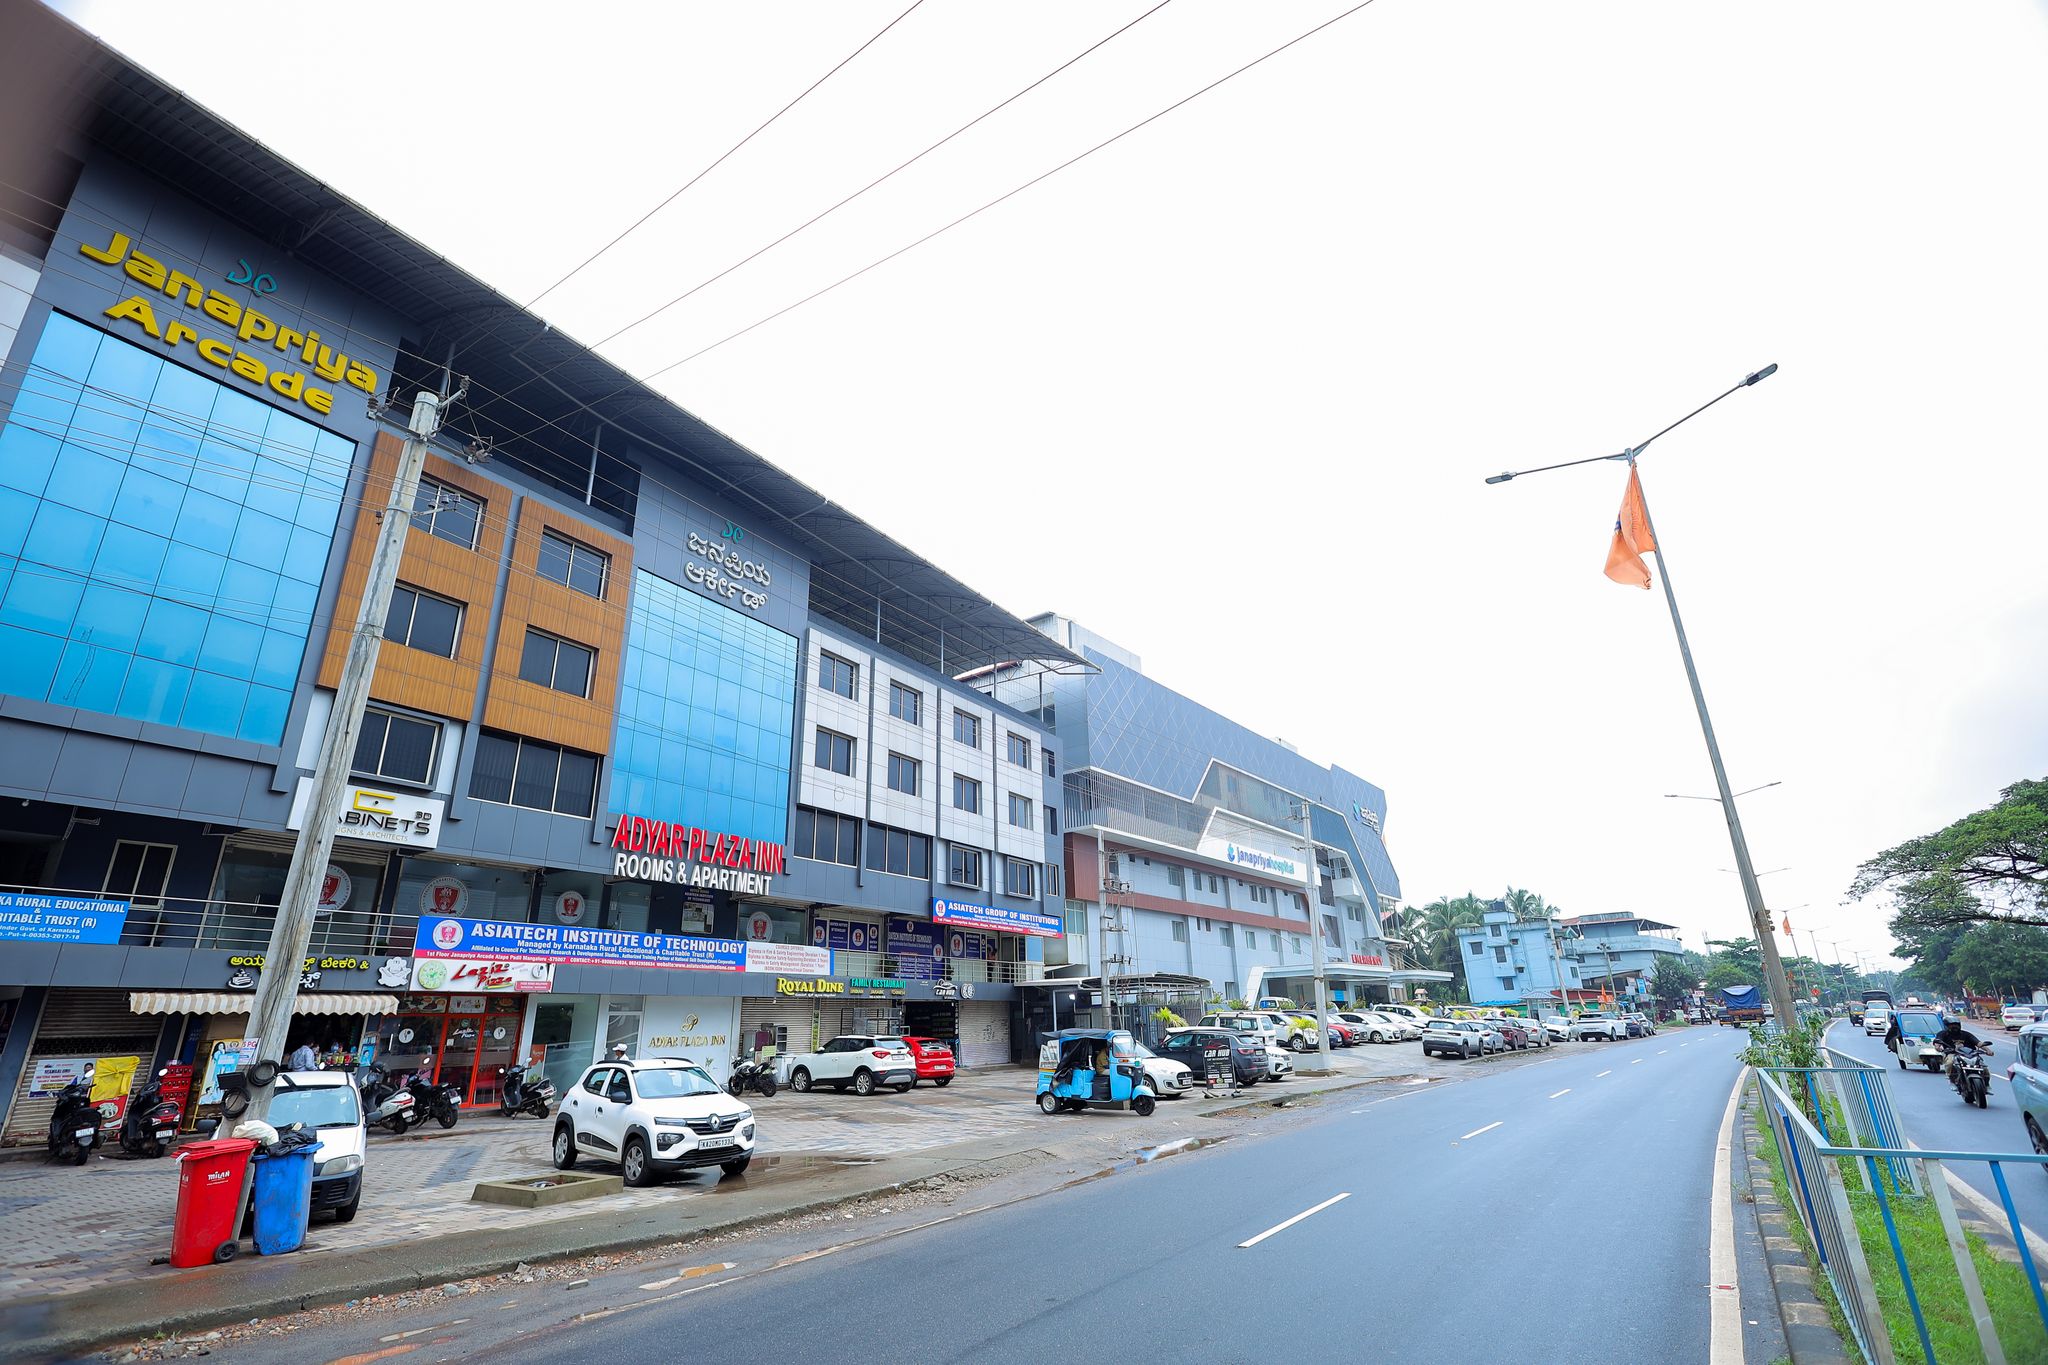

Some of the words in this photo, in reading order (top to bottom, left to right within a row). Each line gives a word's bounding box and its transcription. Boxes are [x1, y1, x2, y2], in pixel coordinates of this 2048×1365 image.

[80, 232, 378, 393] Janapriya
[103, 295, 335, 416] Arcade
[688, 532, 771, 586] ಜನಪ್ರಿಯ
[338, 811, 431, 836] BINETS
[415, 811, 432, 820] 3D
[366, 831, 409, 842] ARCHITECTS
[611, 814, 685, 859] ADYAR
[688, 827, 752, 869] PLAZA
[754, 840, 784, 876] INN
[614, 852, 673, 883] ROOMS
[677, 861, 687, 885] &
[690, 865, 772, 896] APARTMENT
[16, 897, 51, 908] RURAL
[55, 899, 125, 913] EDUCATIONAL
[45, 915, 79, 926] TRUST
[82, 917, 96, 928] (R)
[948, 902, 983, 914] ASIATECH
[985, 908, 1008, 917] GROUP
[1009, 911, 1018, 919] OF
[1020, 913, 1059, 926] INSTITUTIONS
[471, 923, 558, 941] ASIATECH
[563, 929, 640, 946] INSTITUTE
[643, 936, 661, 948] OF
[665, 938, 744, 954] TECHNOLOGY
[517, 940, 552, 949] Managed
[553, 941, 563, 949] by
[563, 943, 598, 951] Karnataka
[619, 946, 653, 954] Educational
[662, 949, 691, 957] Charitable
[320, 957, 356, 969] ಬೇಕರಿ
[360, 960, 369, 969] &
[475, 976, 512, 988] Pizza
[776, 977, 815, 995] ROYAL
[816, 978, 845, 993] DINE
[851, 978, 871, 987] FAMILY
[872, 980, 906, 989] RESTAURANT
[648, 1037, 678, 1048] ADYAR
[681, 1036, 708, 1047] PLAZA
[711, 1035, 726, 1046] INN
